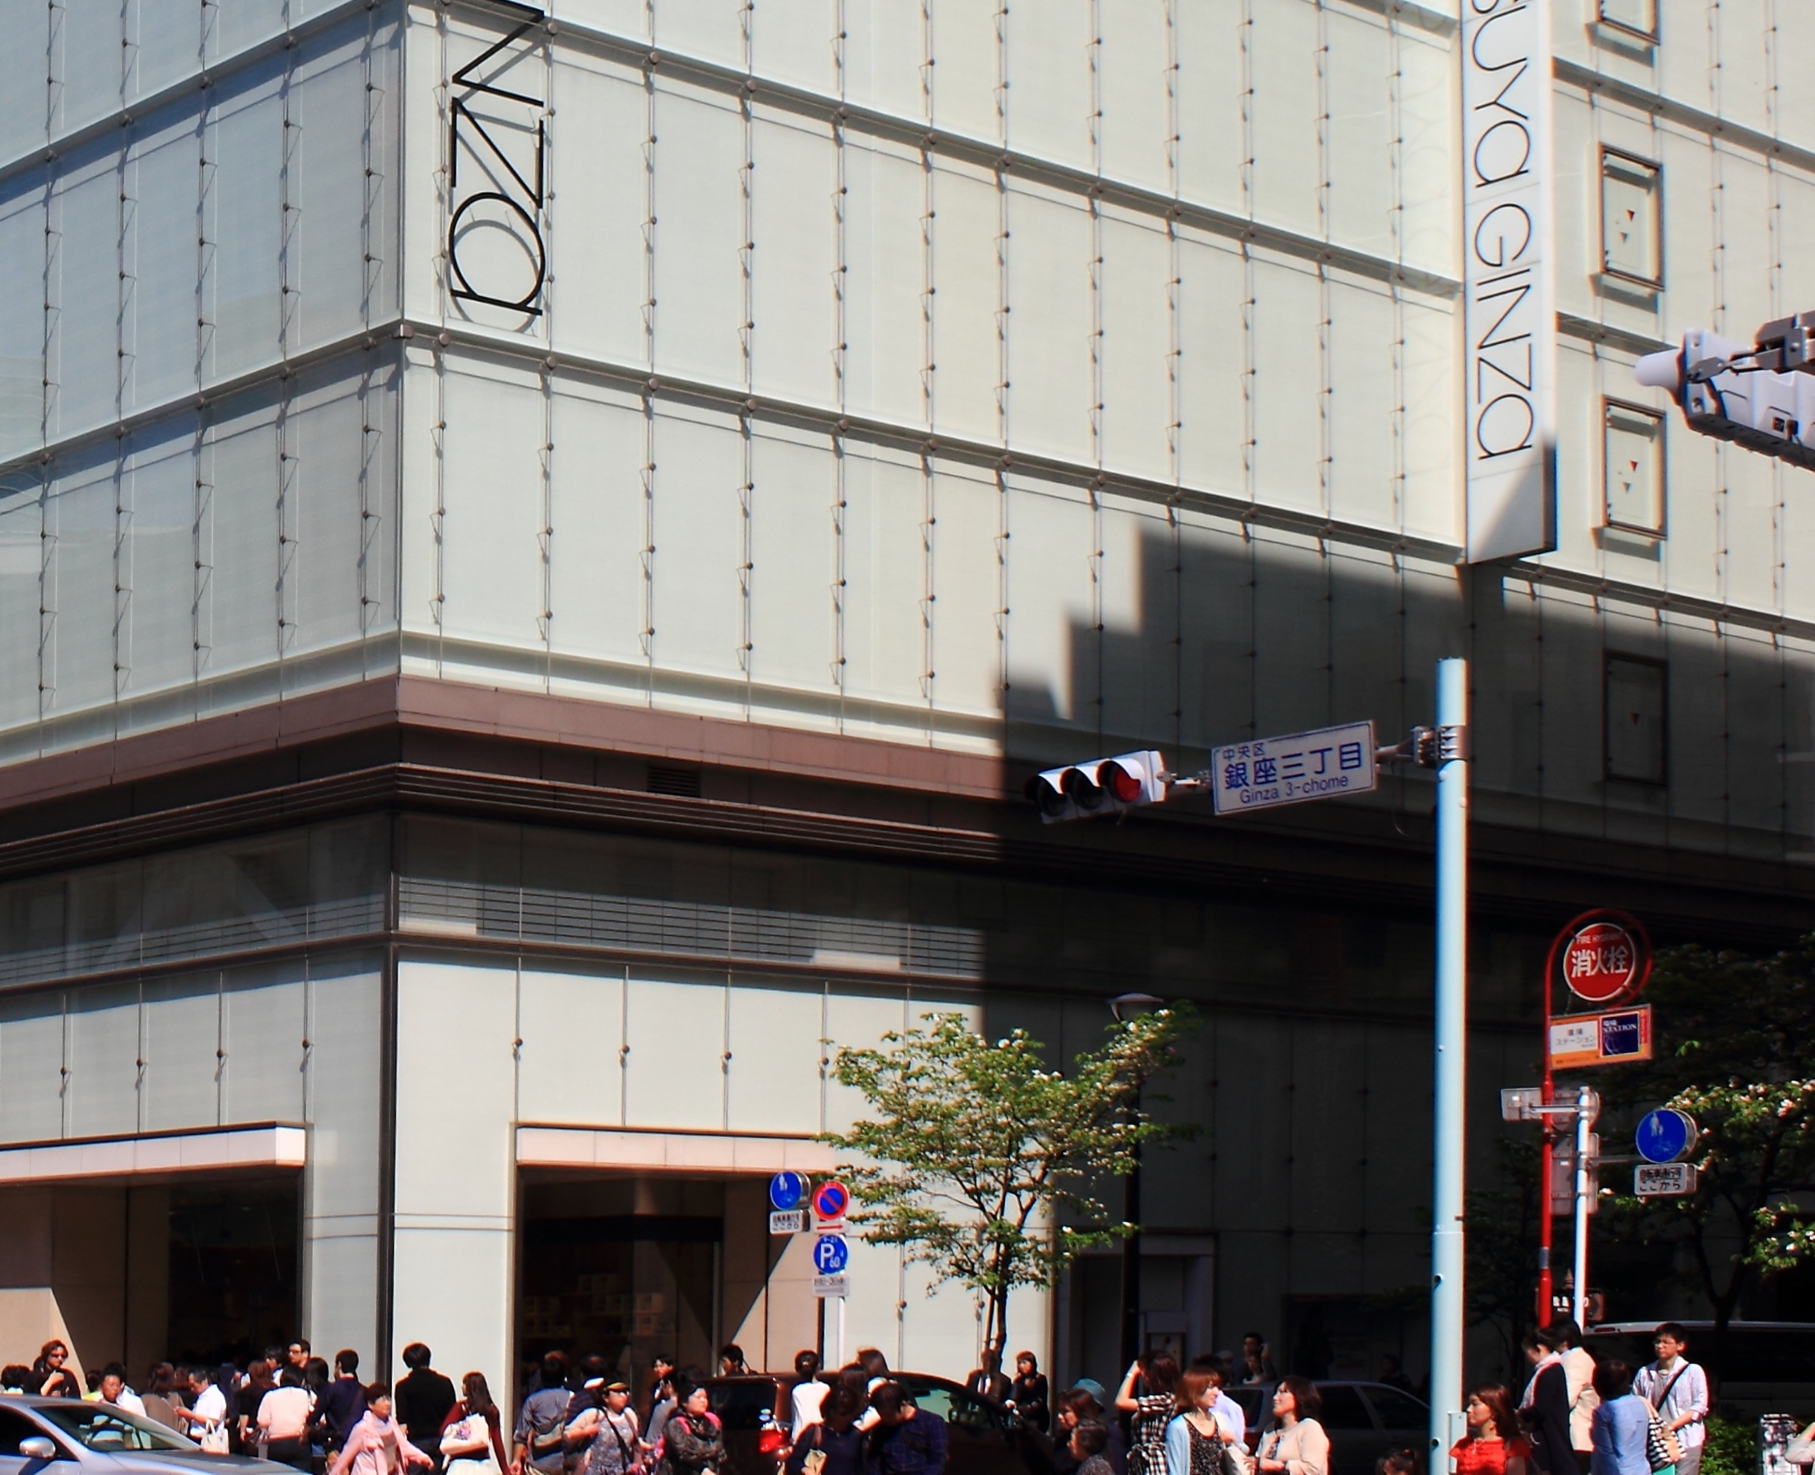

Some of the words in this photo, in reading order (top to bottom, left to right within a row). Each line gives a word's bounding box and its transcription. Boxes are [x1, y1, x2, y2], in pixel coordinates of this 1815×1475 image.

[1222, 742, 1266, 761] 中央区
[1224, 741, 1363, 790] 銀座三丁目
[1239, 784, 1280, 805] Ginza
[1284, 774, 1349, 799] 3-chome
[1576, 935, 1591, 945] FIRE
[1571, 945, 1629, 978] 消火栓
[1639, 1179, 1681, 1192] ここから
[820, 1243, 835, 1269] P
[829, 1256, 841, 1269] 60
